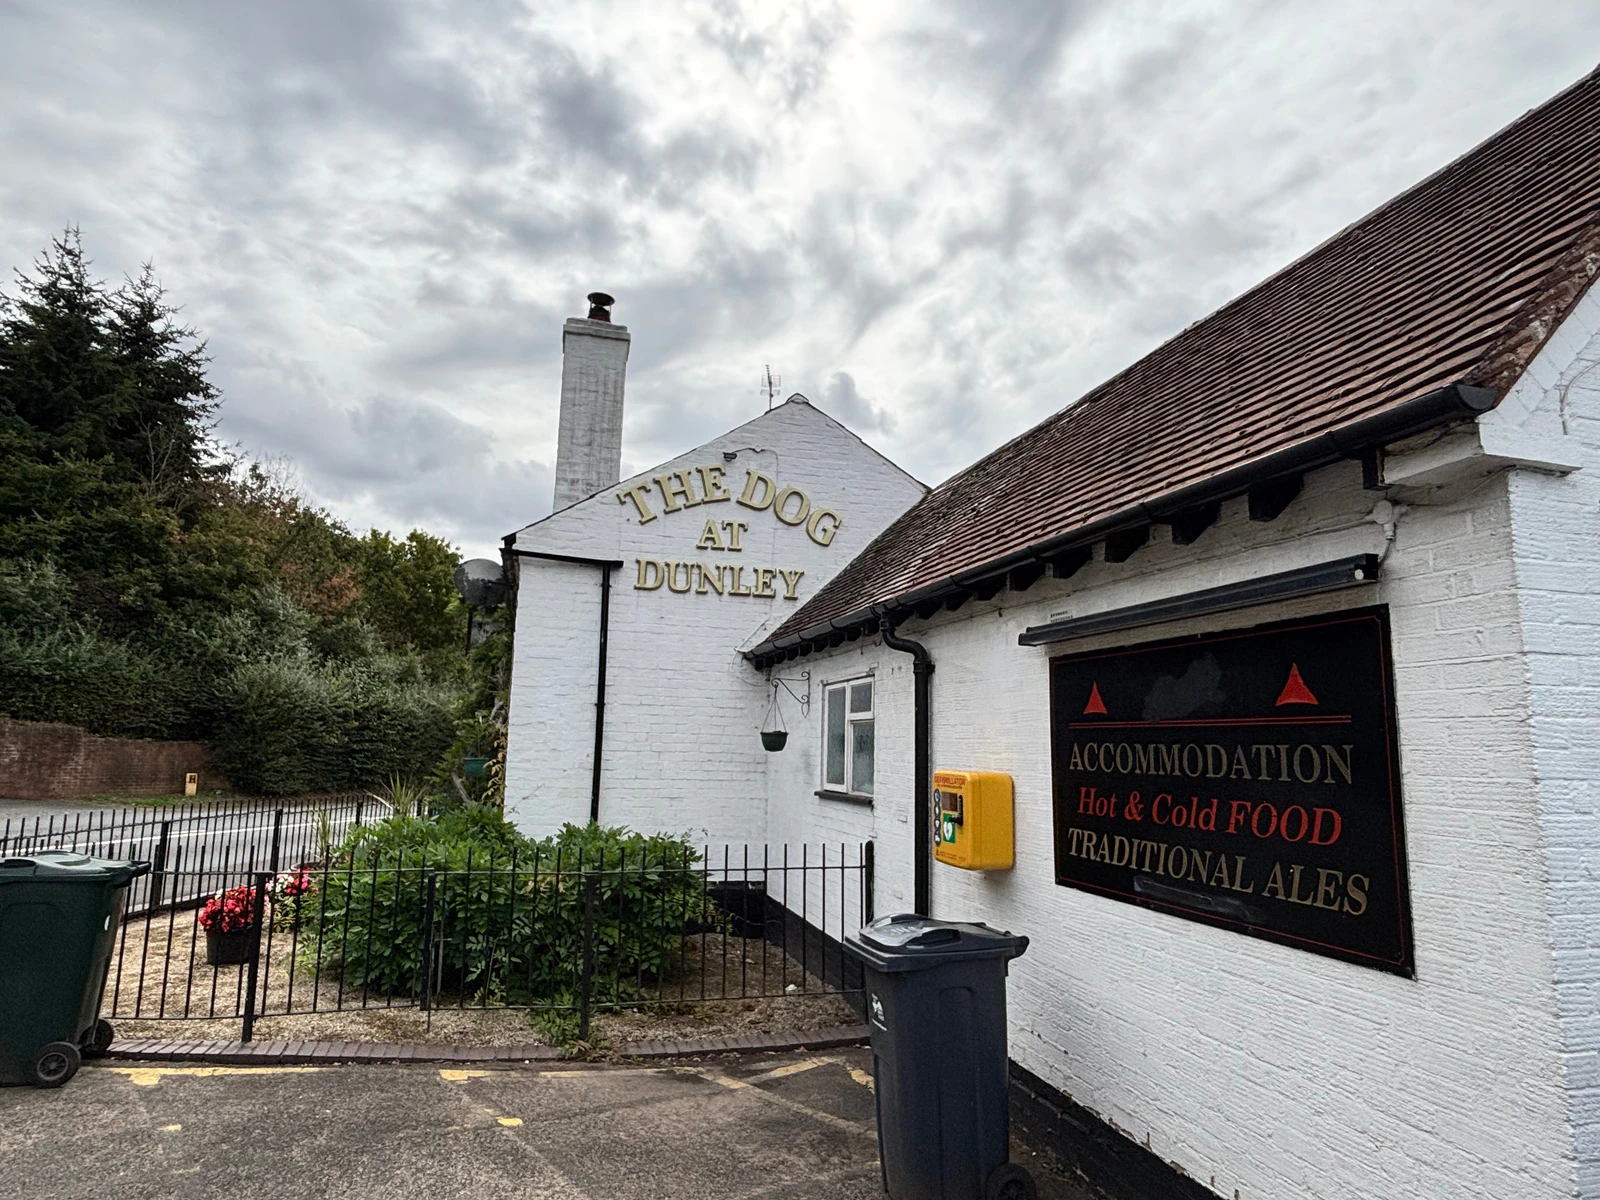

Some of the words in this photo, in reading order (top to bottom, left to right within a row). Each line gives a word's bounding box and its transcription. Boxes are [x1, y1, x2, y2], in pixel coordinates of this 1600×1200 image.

[616, 464, 731, 525] THE
[736, 469, 842, 547] DOG
[696, 519, 748, 551] AT
[633, 558, 805, 600] DUNLEY
[1069, 742, 1354, 784] ACCOMMODATION
[1077, 787, 1117, 818] Hot
[1124, 791, 1144, 822] &
[1152, 793, 1218, 831] Cold
[1225, 800, 1342, 846] FOOD
[1068, 827, 1254, 893] TRADITIONAL
[1261, 861, 1370, 916] ALES
